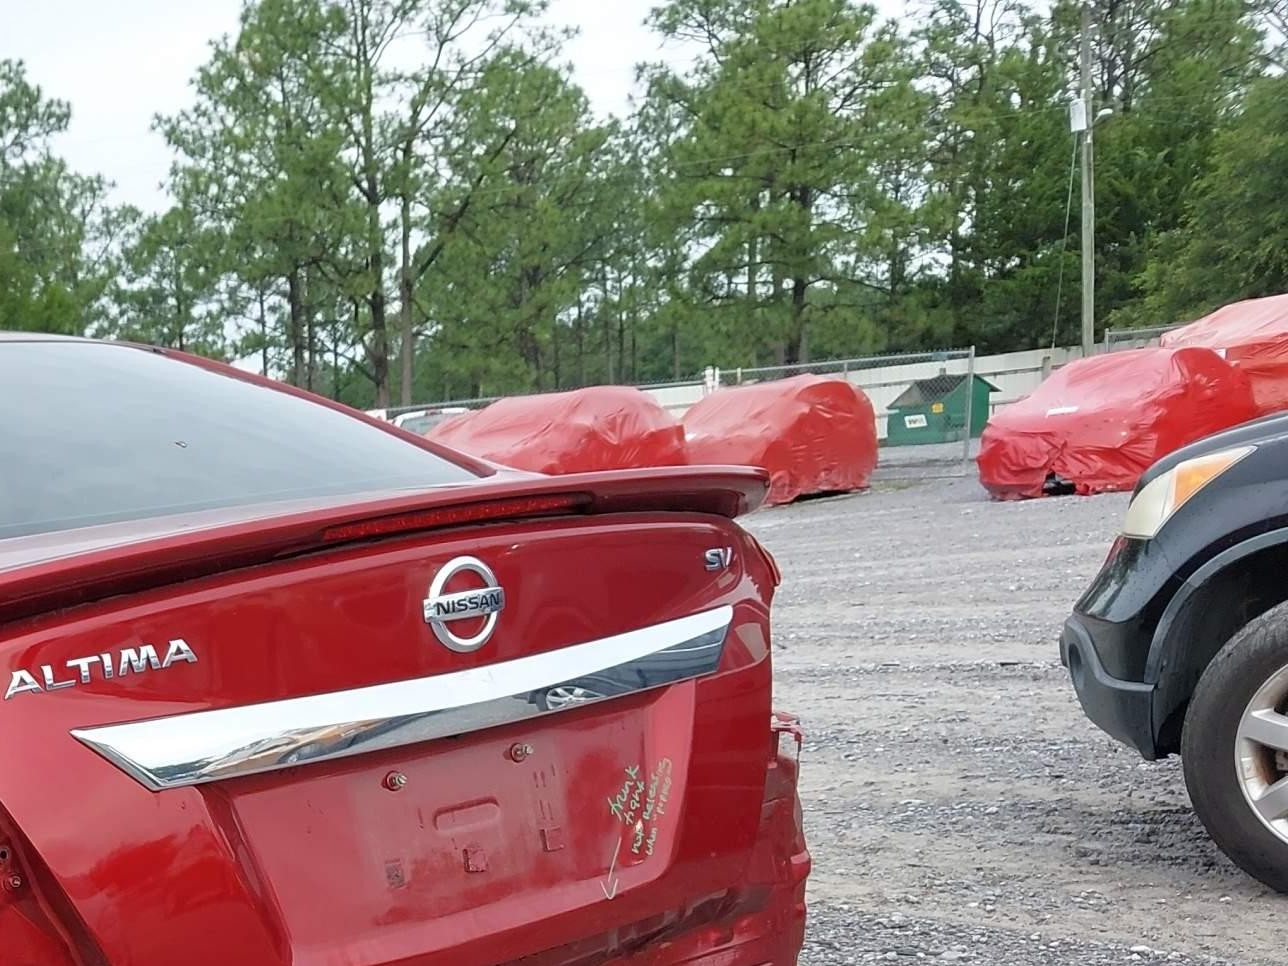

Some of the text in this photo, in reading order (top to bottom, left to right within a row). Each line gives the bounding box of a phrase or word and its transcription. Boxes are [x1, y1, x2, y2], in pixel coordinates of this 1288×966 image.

[704, 546, 732, 571] SV
[436, 591, 501, 616] NISSAN
[4, 638, 198, 700] ALTIMA
